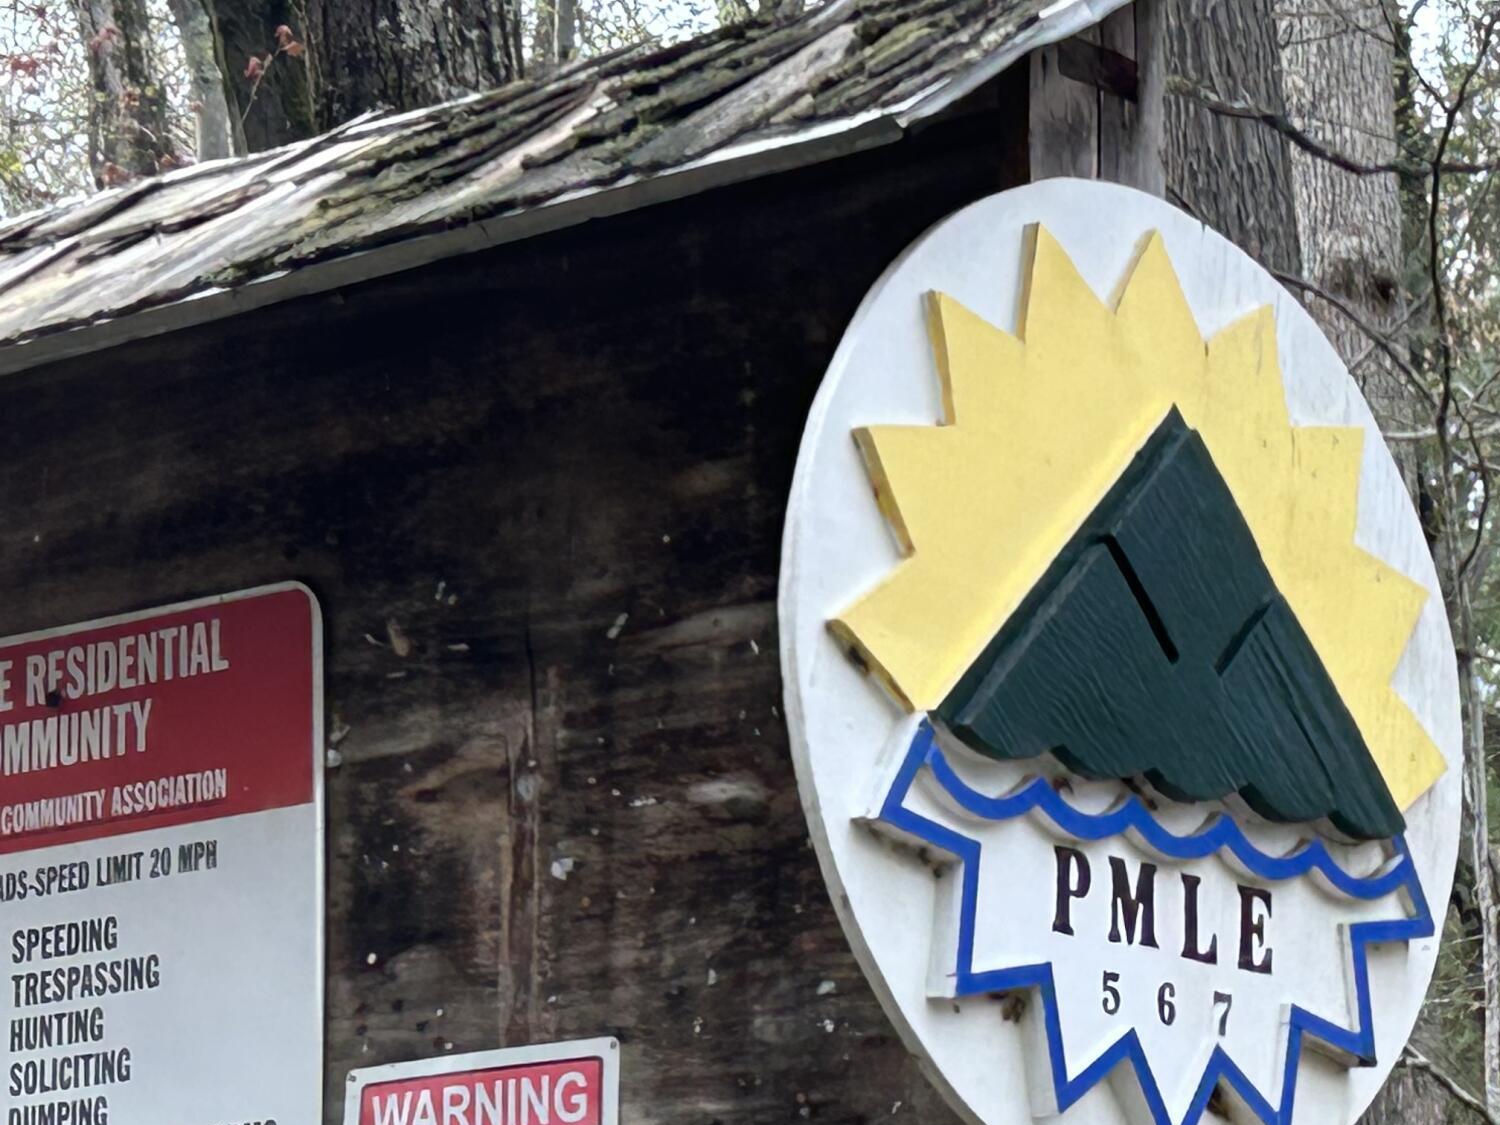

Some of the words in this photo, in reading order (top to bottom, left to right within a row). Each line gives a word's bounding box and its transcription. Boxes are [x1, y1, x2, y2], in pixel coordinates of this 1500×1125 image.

[26, 618, 229, 707] RESIDENTIAL
[0, 698, 152, 776] MMUNITY
[1, 789, 106, 835] COMMUNITY
[111, 768, 228, 817] ASSOCIATION
[96, 852, 144, 886] LIMIT
[149, 847, 171, 878] 20
[178, 840, 217, 873] MPH
[1052, 844, 1273, 975] PMLE
[12, 916, 118, 964] SPEEDING
[11, 954, 160, 1008] TRESPASSING
[1102, 970, 1121, 1016] 5
[1158, 982, 1176, 1026] 6
[1214, 991, 1232, 1036] 7
[9, 1007, 104, 1053] HUNTING
[9, 1047, 131, 1097] SOLICITING
